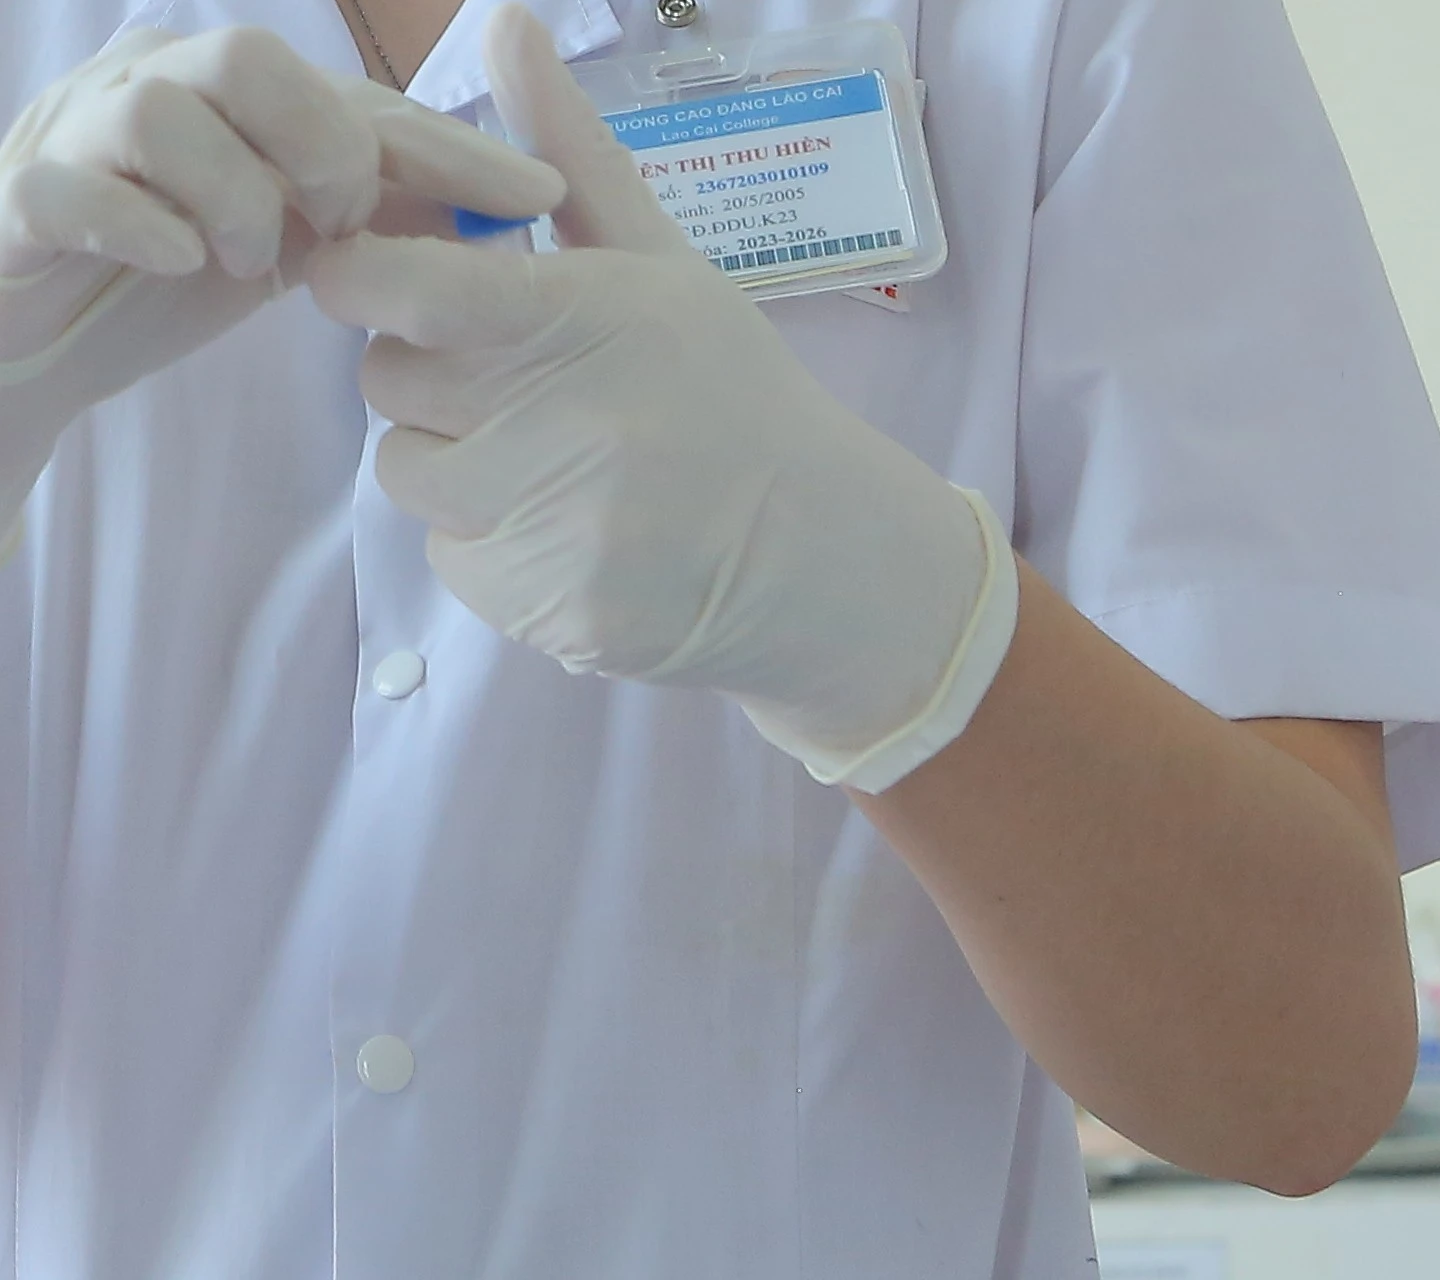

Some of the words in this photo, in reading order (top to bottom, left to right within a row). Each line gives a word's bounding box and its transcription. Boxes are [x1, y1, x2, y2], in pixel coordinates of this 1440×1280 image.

[675, 107, 712, 122] CAO
[812, 85, 842, 100] CAI
[674, 155, 716, 173] THỊ
[721, 146, 769, 166] THU
[696, 162, 829, 195] 2367203010109
[674, 204, 715, 219] sinh:
[722, 187, 806, 211] 20/5/2005
[737, 226, 827, 251] 2023-2026
